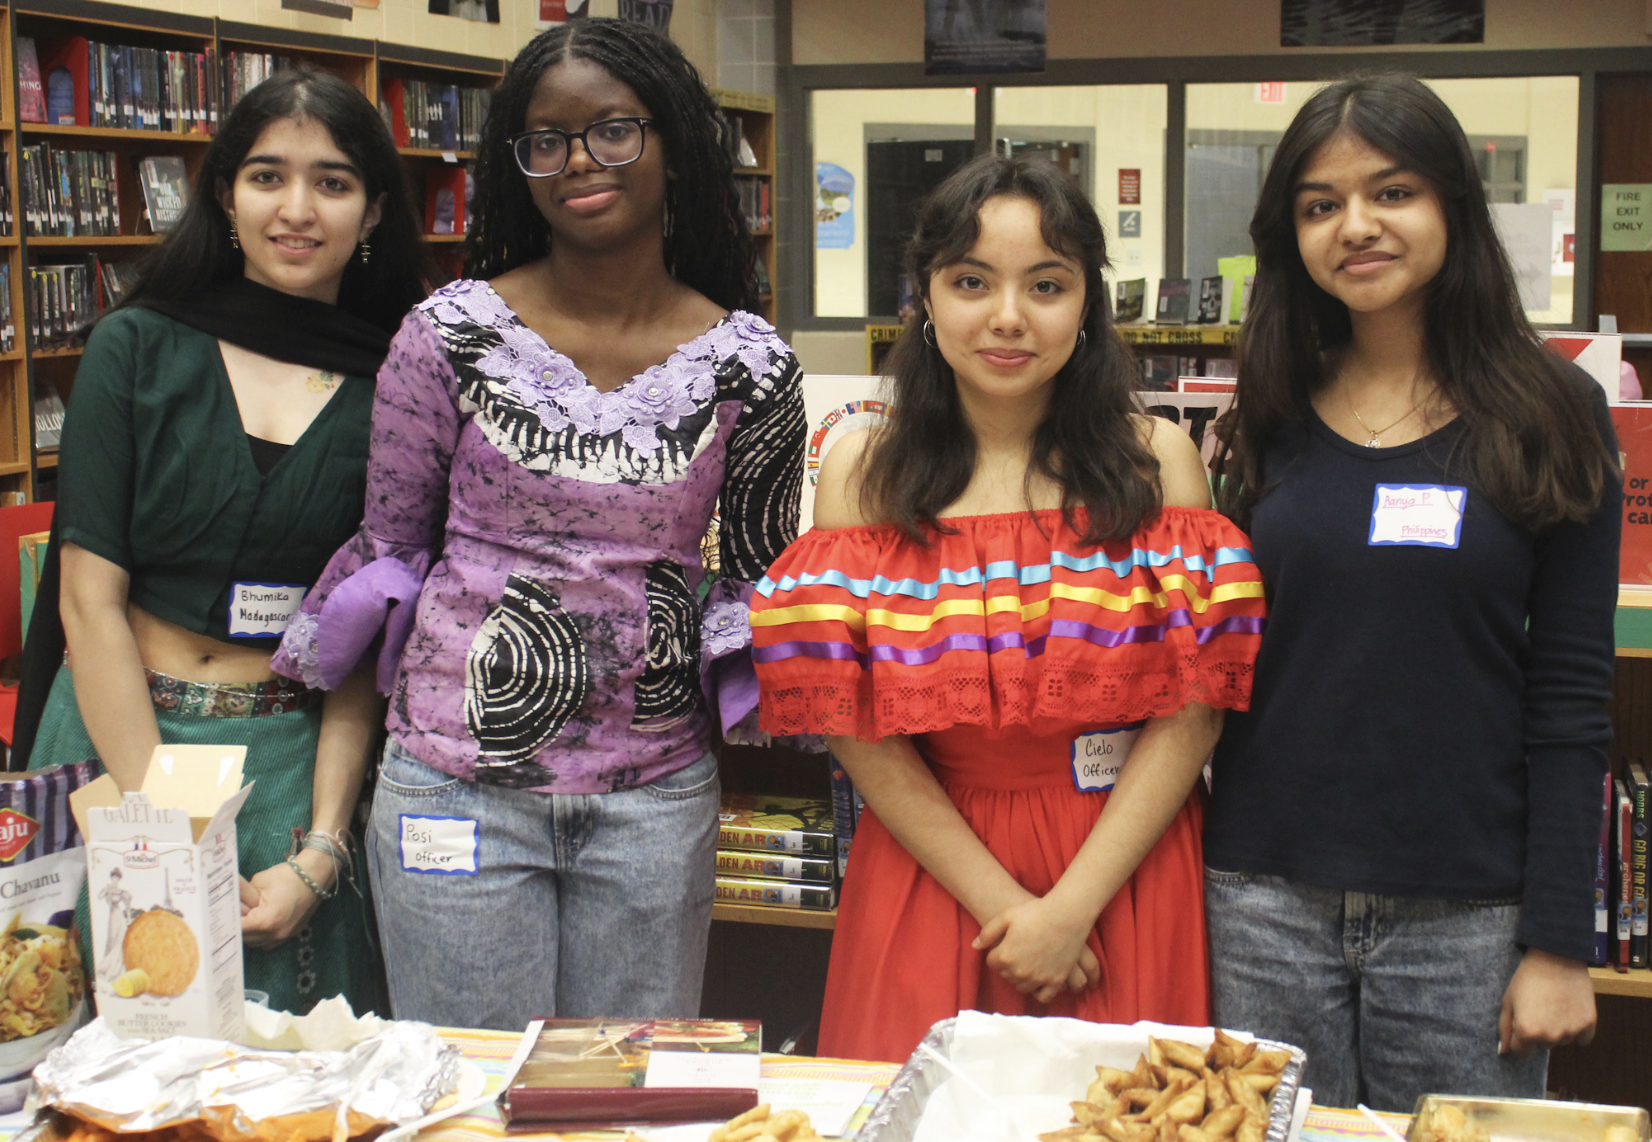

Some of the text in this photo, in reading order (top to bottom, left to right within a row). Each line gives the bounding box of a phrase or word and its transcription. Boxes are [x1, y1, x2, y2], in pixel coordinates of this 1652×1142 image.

[1616, 192, 1641, 200] FIRE
[1616, 207, 1640, 216] EXIT
[1613, 222, 1643, 231] ONLY
[1124, 332, 1138, 343] DO
[1143, 332, 1163, 343] NOT
[1168, 332, 1203, 343] CROSS
[1629, 478, 1649, 489] or
[1628, 512, 1652, 524] ca
[1402, 525, 1448, 537] Philippines
[1085, 738, 1113, 757] Cielo
[1083, 763, 1120, 778] Officer
[1636, 790, 1645, 818] HOBBS
[1634, 840, 1647, 852] GO
[717, 856, 739, 869] DEN
[1634, 854, 1647, 870] BIG
[1634, 871, 1646, 885] OR
[0, 872, 61, 899] Chavanu
[118, 1019, 148, 1027] BUTTER
